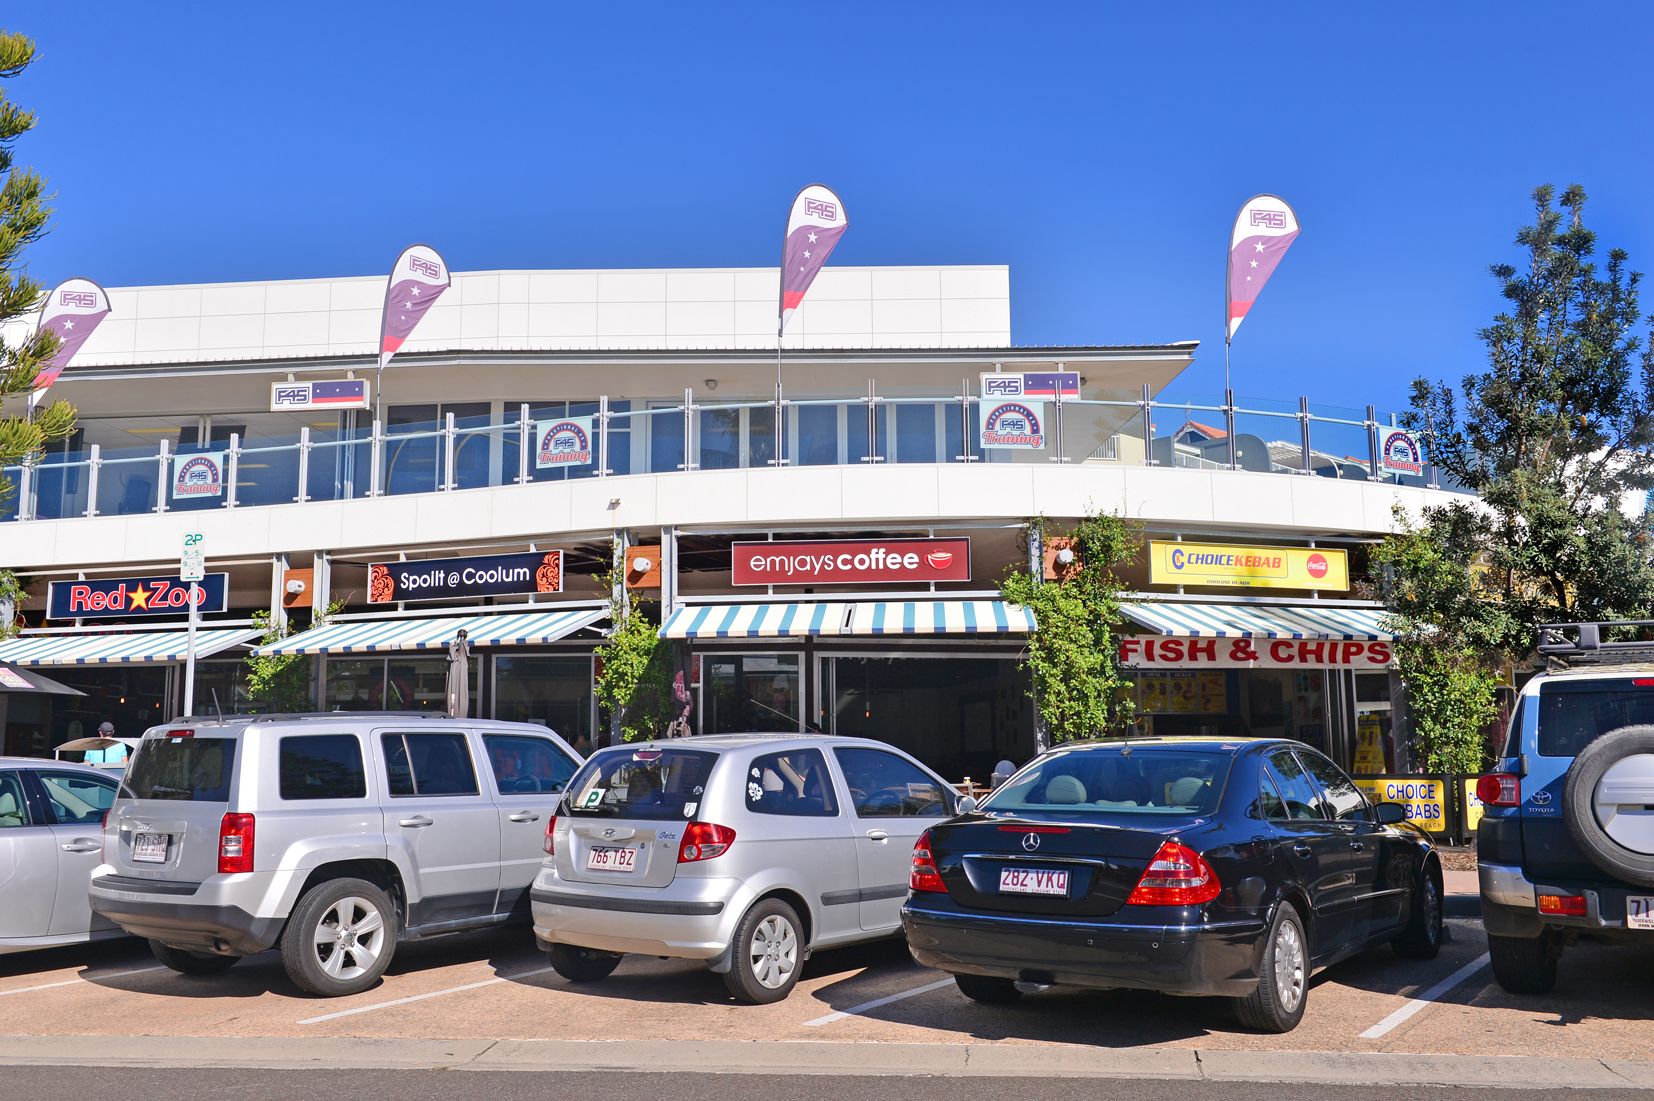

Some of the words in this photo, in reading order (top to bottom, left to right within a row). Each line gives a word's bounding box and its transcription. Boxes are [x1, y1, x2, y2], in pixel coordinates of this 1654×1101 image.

[805, 198, 836, 220] F45
[1251, 210, 1285, 228] F45
[410, 256, 439, 278] F45
[61, 292, 95, 307] F45
[276, 387, 309, 403] F45
[986, 379, 1021, 395] F45
[1000, 418, 1025, 430] F45
[554, 436, 575, 448] F45
[983, 431, 1043, 448] Training
[539, 450, 590, 464] Training
[1383, 456, 1421, 474] Training
[189, 470, 208, 481] F45
[176, 482, 220, 495] Training
[184, 534, 203, 546] 2P
[400, 569, 445, 590] Spoilt
[447, 572, 460, 587] @
[462, 566, 530, 585] Coolum
[70, 583, 126, 612] Red
[148, 581, 206, 608] Zoo
[1120, 639, 1217, 662] FISH
[1229, 638, 1259, 662] &
[1269, 640, 1391, 665] CHIPS
[584, 791, 600, 808] P
[1386, 783, 1436, 800] CHOICE
[1405, 803, 1441, 819] BABS
